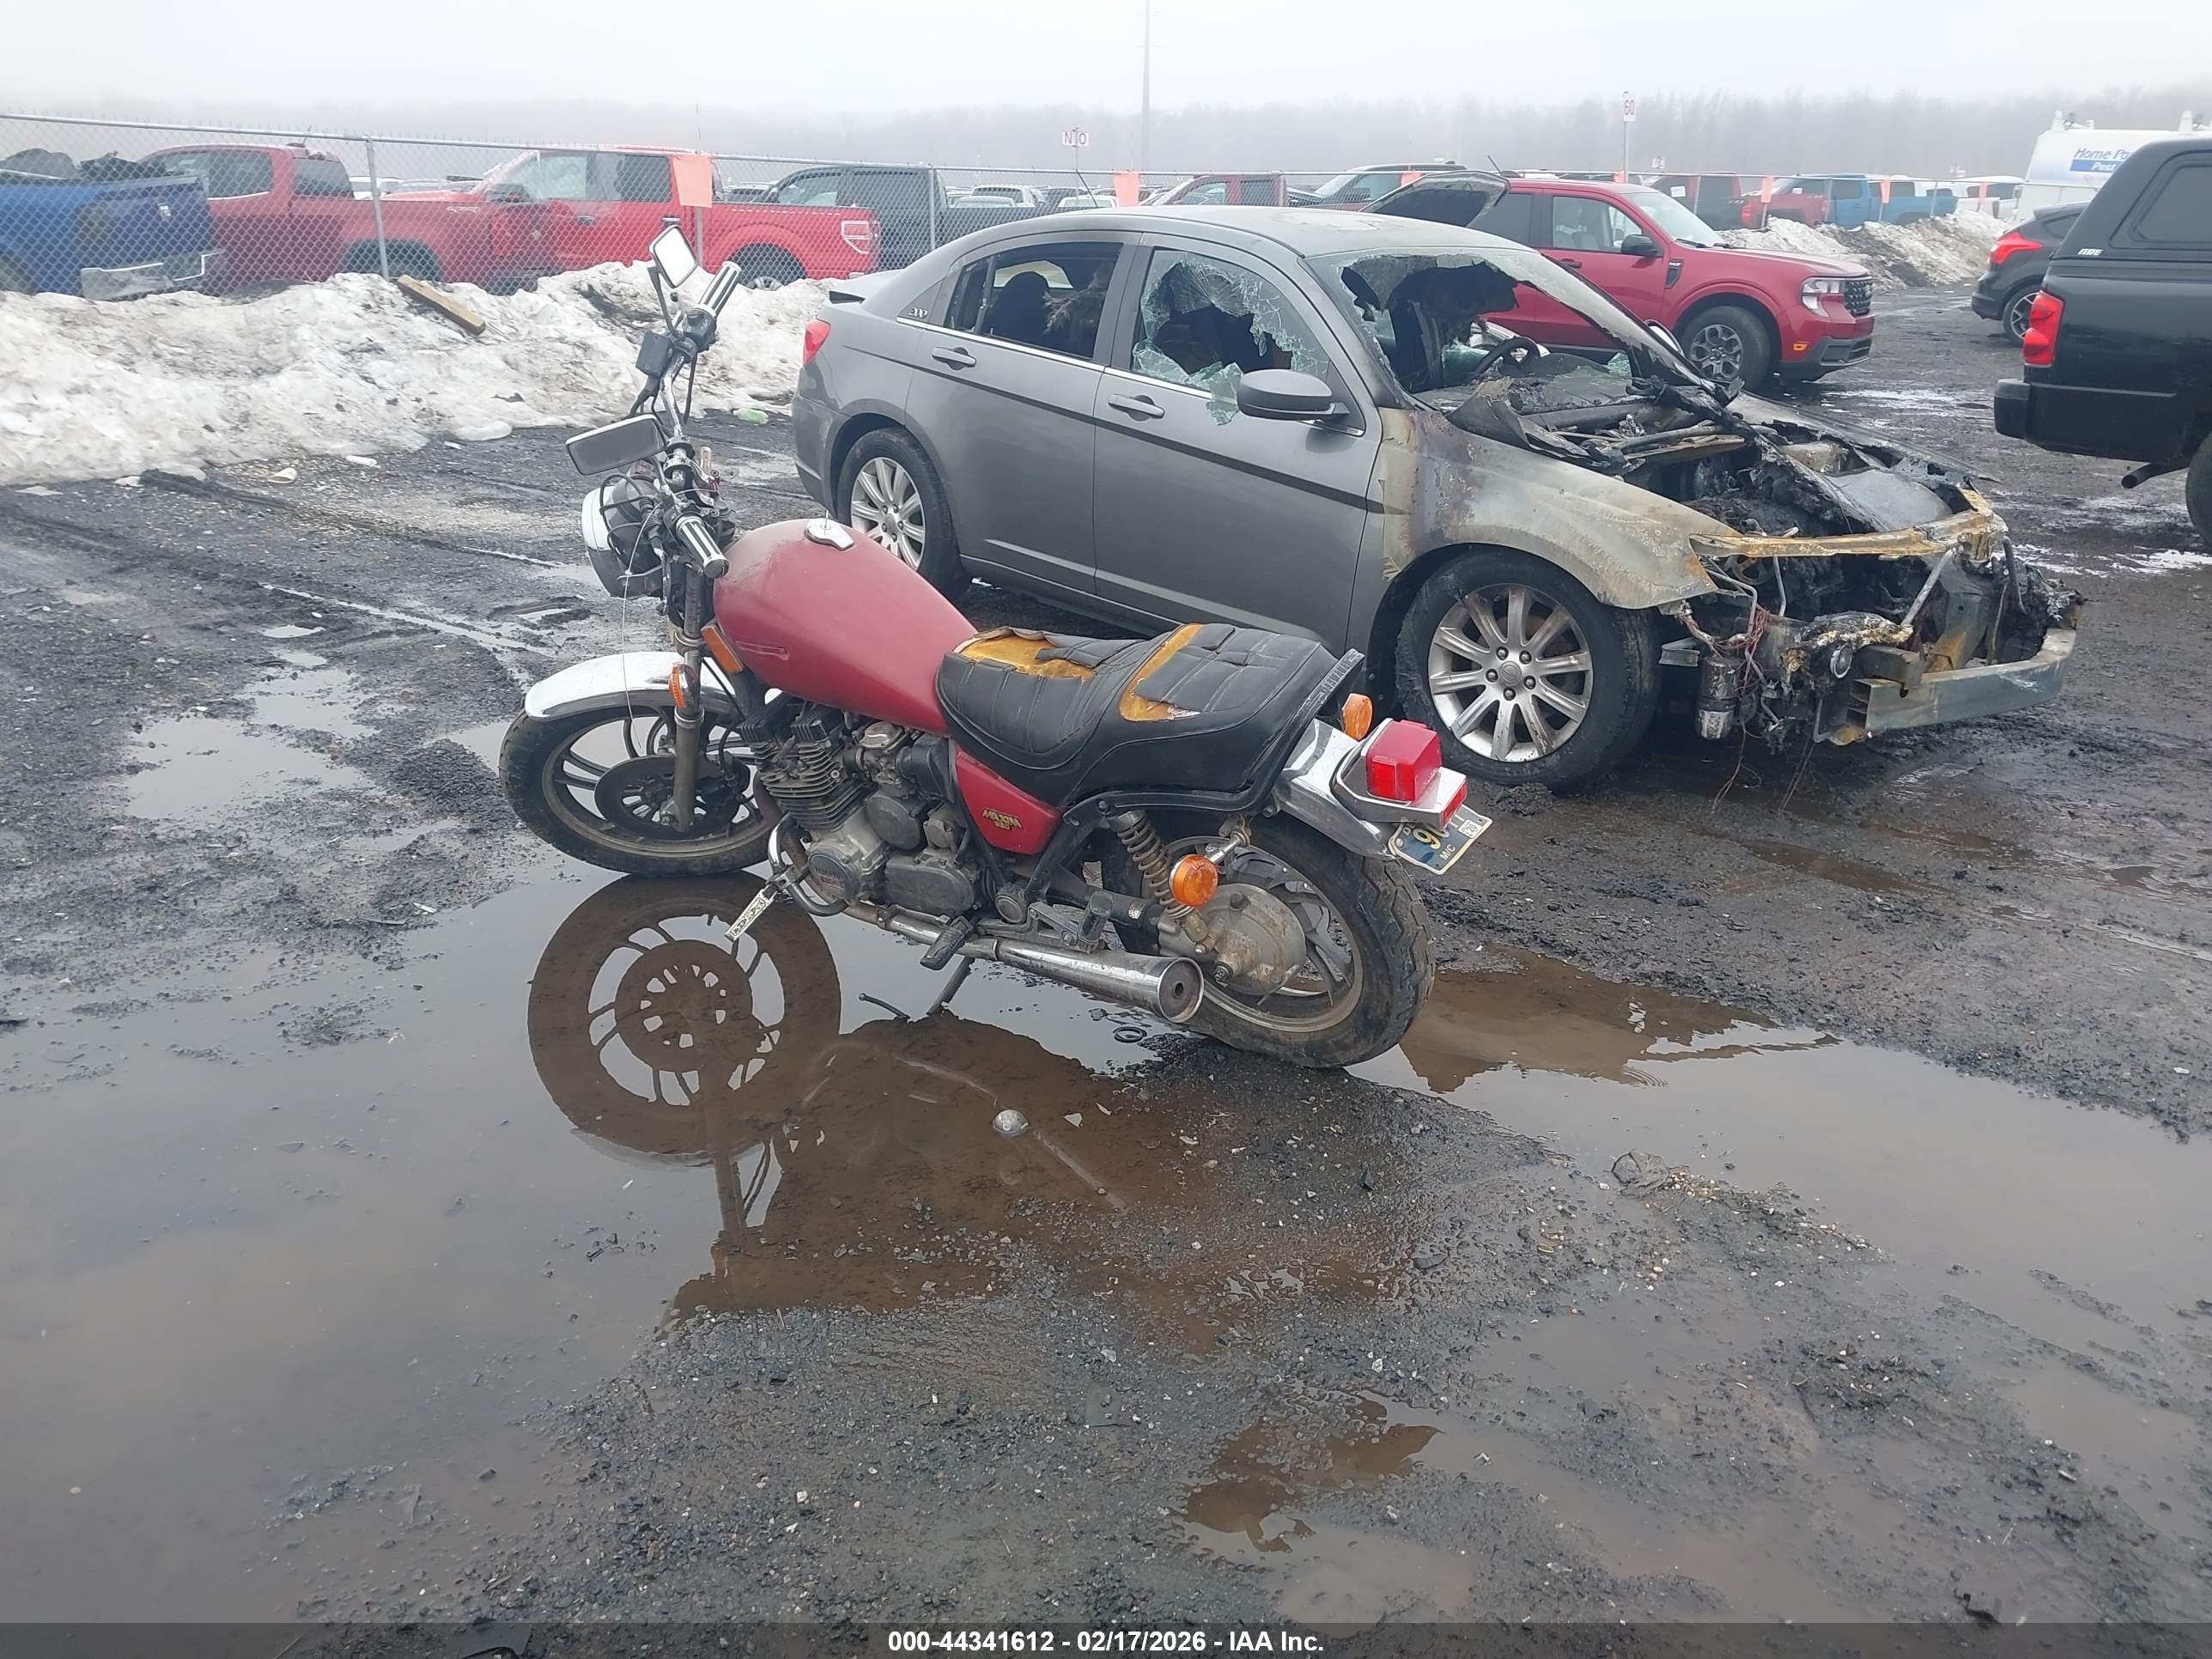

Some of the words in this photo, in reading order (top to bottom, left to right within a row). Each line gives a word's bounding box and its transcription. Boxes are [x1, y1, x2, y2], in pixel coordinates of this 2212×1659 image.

[2073, 148, 2112, 160] Home
[2090, 161, 2117, 172] Pest
[1439, 844, 1456, 861] M/C
